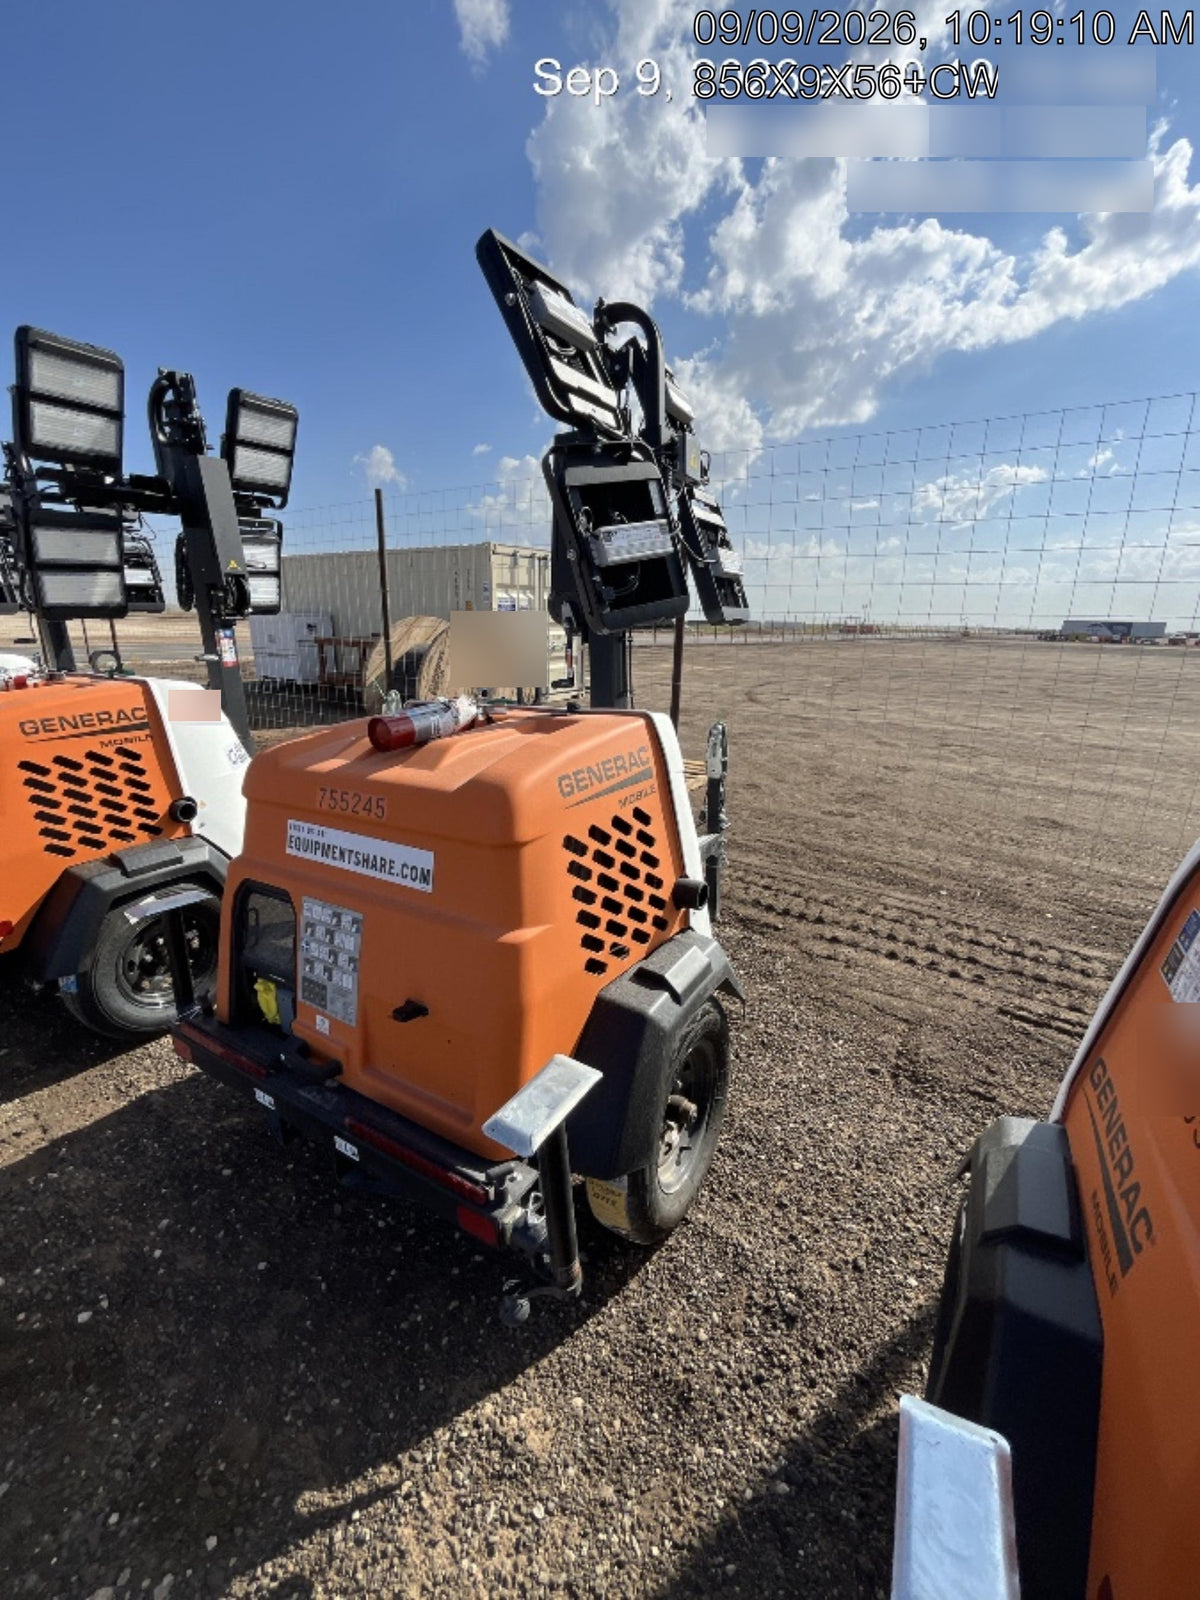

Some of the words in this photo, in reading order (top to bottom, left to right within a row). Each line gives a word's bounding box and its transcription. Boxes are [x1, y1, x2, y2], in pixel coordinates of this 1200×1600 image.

[20, 706, 147, 736] GENERAC
[557, 745, 650, 798] GENERAC
[319, 787, 386, 819] 755245
[288, 834, 431, 886] EQUIPMENTSHARE.COM
[1089, 1057, 1153, 1254] GENERAC
